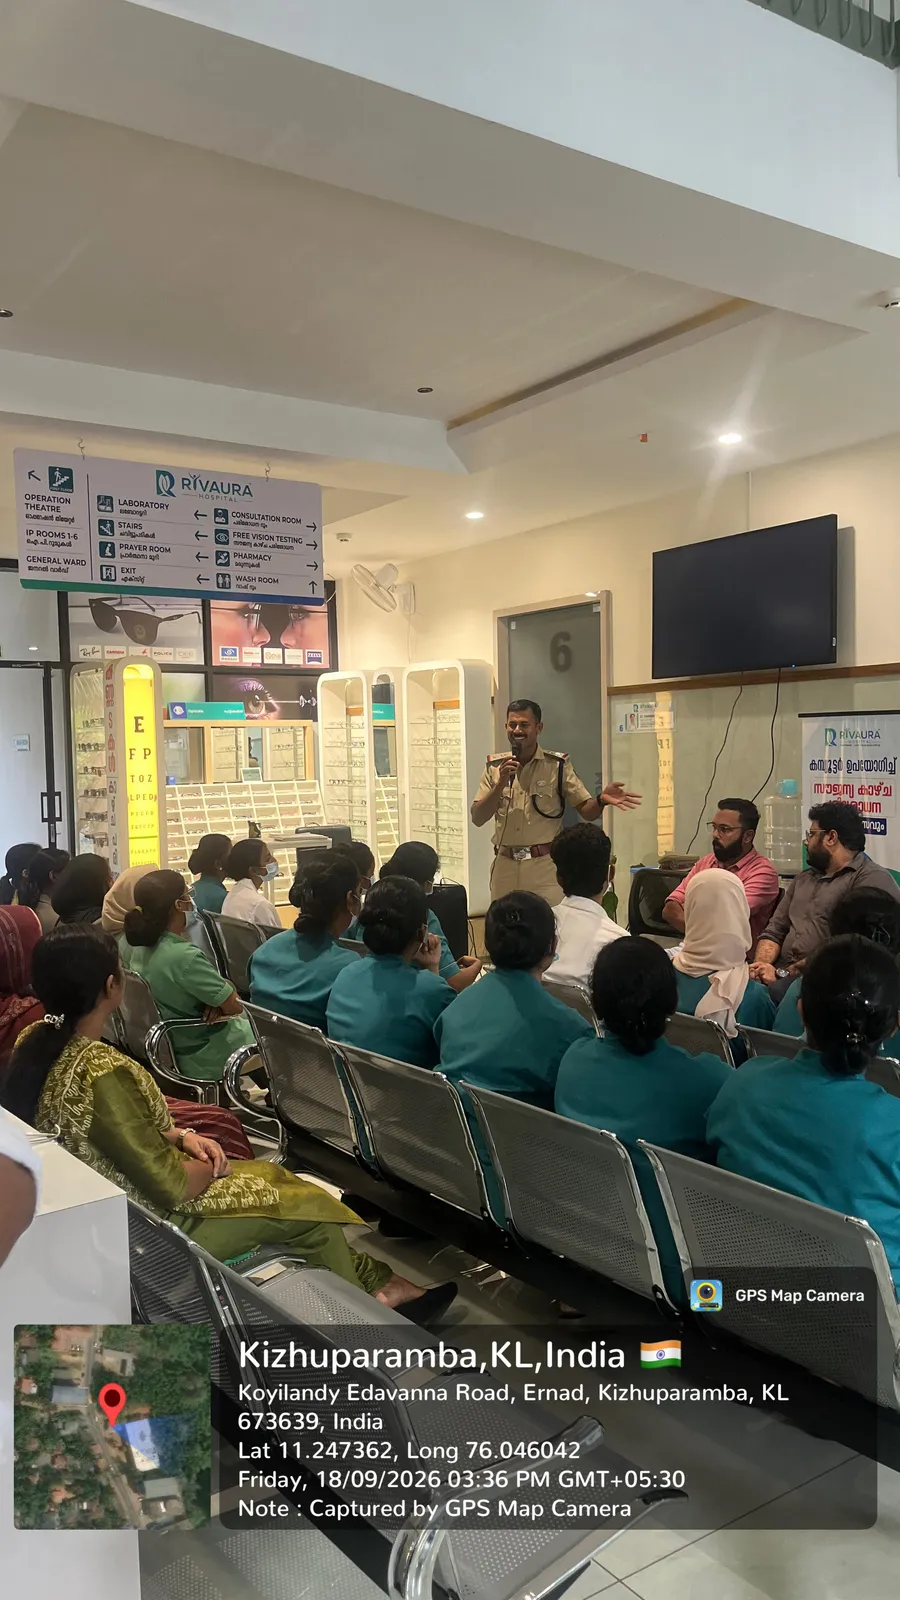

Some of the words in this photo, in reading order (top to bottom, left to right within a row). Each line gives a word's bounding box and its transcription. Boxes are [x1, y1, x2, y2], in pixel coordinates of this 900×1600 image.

[181, 473, 253, 497] RIVAURA
[24, 494, 70, 504] OPERATION
[198, 494, 237, 502] HOSPITAL
[24, 503, 61, 512] THEATRE
[118, 499, 169, 510] LABORATORY
[232, 512, 280, 522] CONSULTATION
[282, 516, 302, 524] ROOM
[118, 522, 142, 530] STAIRS
[36, 530, 65, 539] ROOMS
[252, 534, 274, 542] VISION
[276, 536, 303, 544] TESTING
[120, 544, 147, 552] PRAYER
[26, 555, 61, 564] GENERAL
[63, 558, 86, 566] WARD
[233, 552, 272, 561] PHARMACY
[235, 575, 256, 583] WASH
[550, 631, 572, 672] 6
[134, 716, 144, 733] E
[840, 728, 880, 740] RIVAURA
